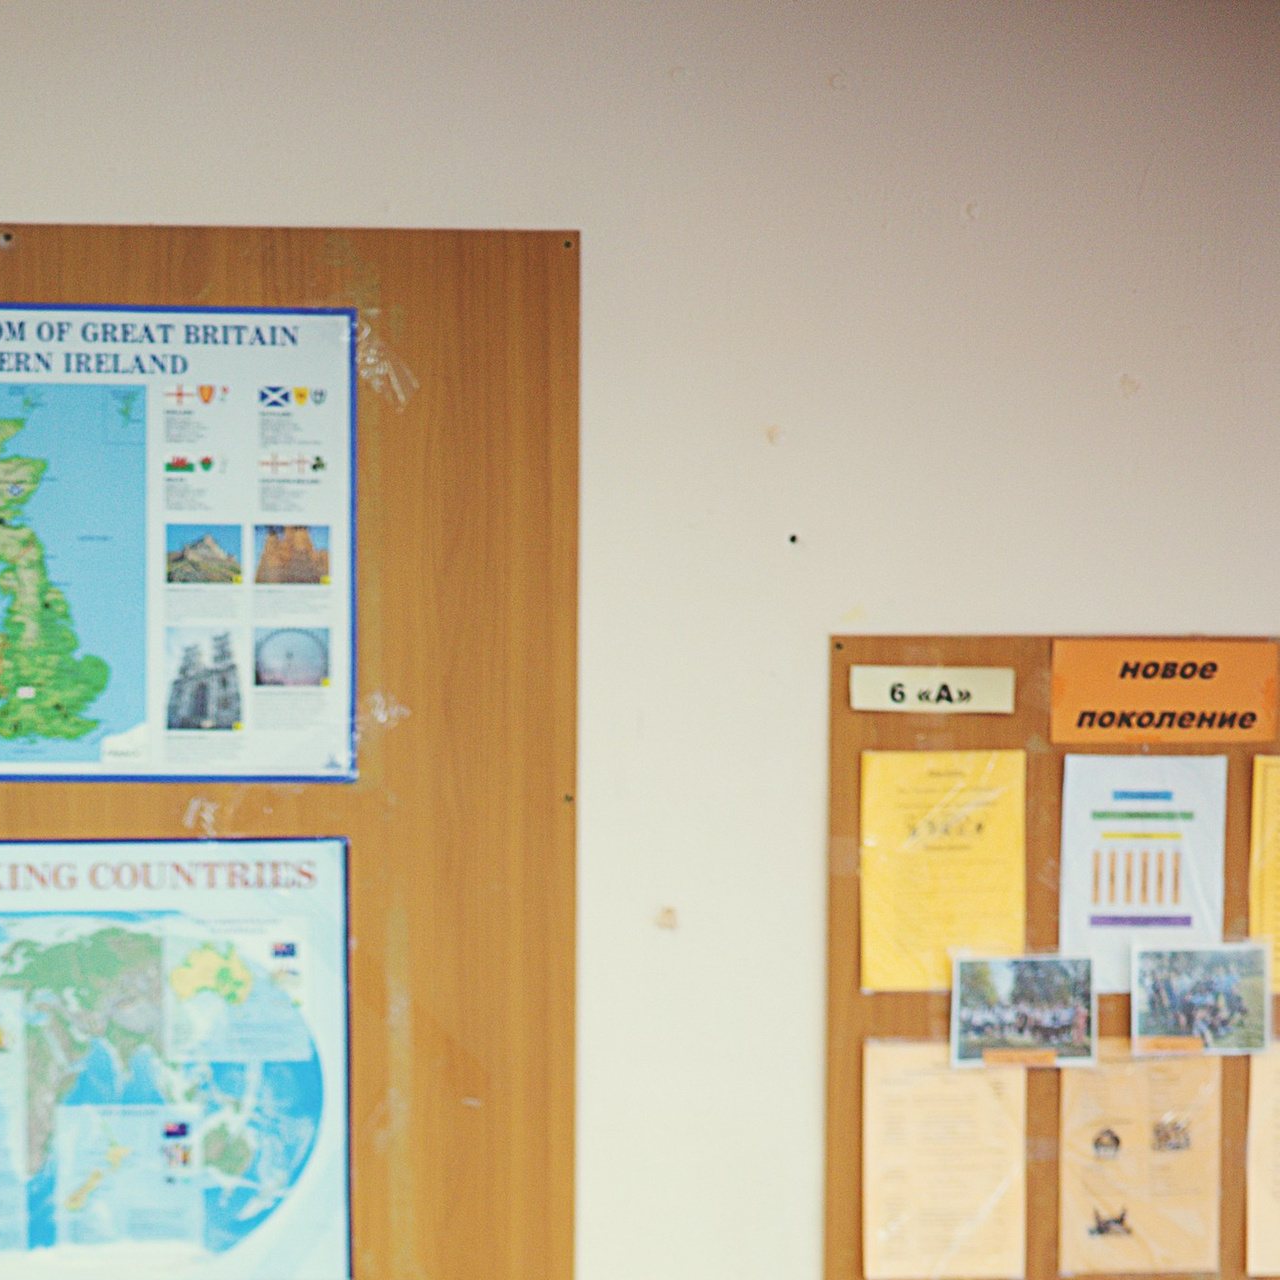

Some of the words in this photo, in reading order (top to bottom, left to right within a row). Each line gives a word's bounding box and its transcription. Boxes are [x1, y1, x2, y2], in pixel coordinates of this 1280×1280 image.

[36, 321, 72, 342] OF
[81, 321, 174, 344] GREAT
[184, 323, 299, 346] BRITAIN
[64, 352, 188, 375] IRELAND
[1119, 661, 1218, 680] новое
[890, 682, 906, 704] 6
[1077, 711, 1257, 730] поколение
[88, 860, 318, 890] COUNTRIES
